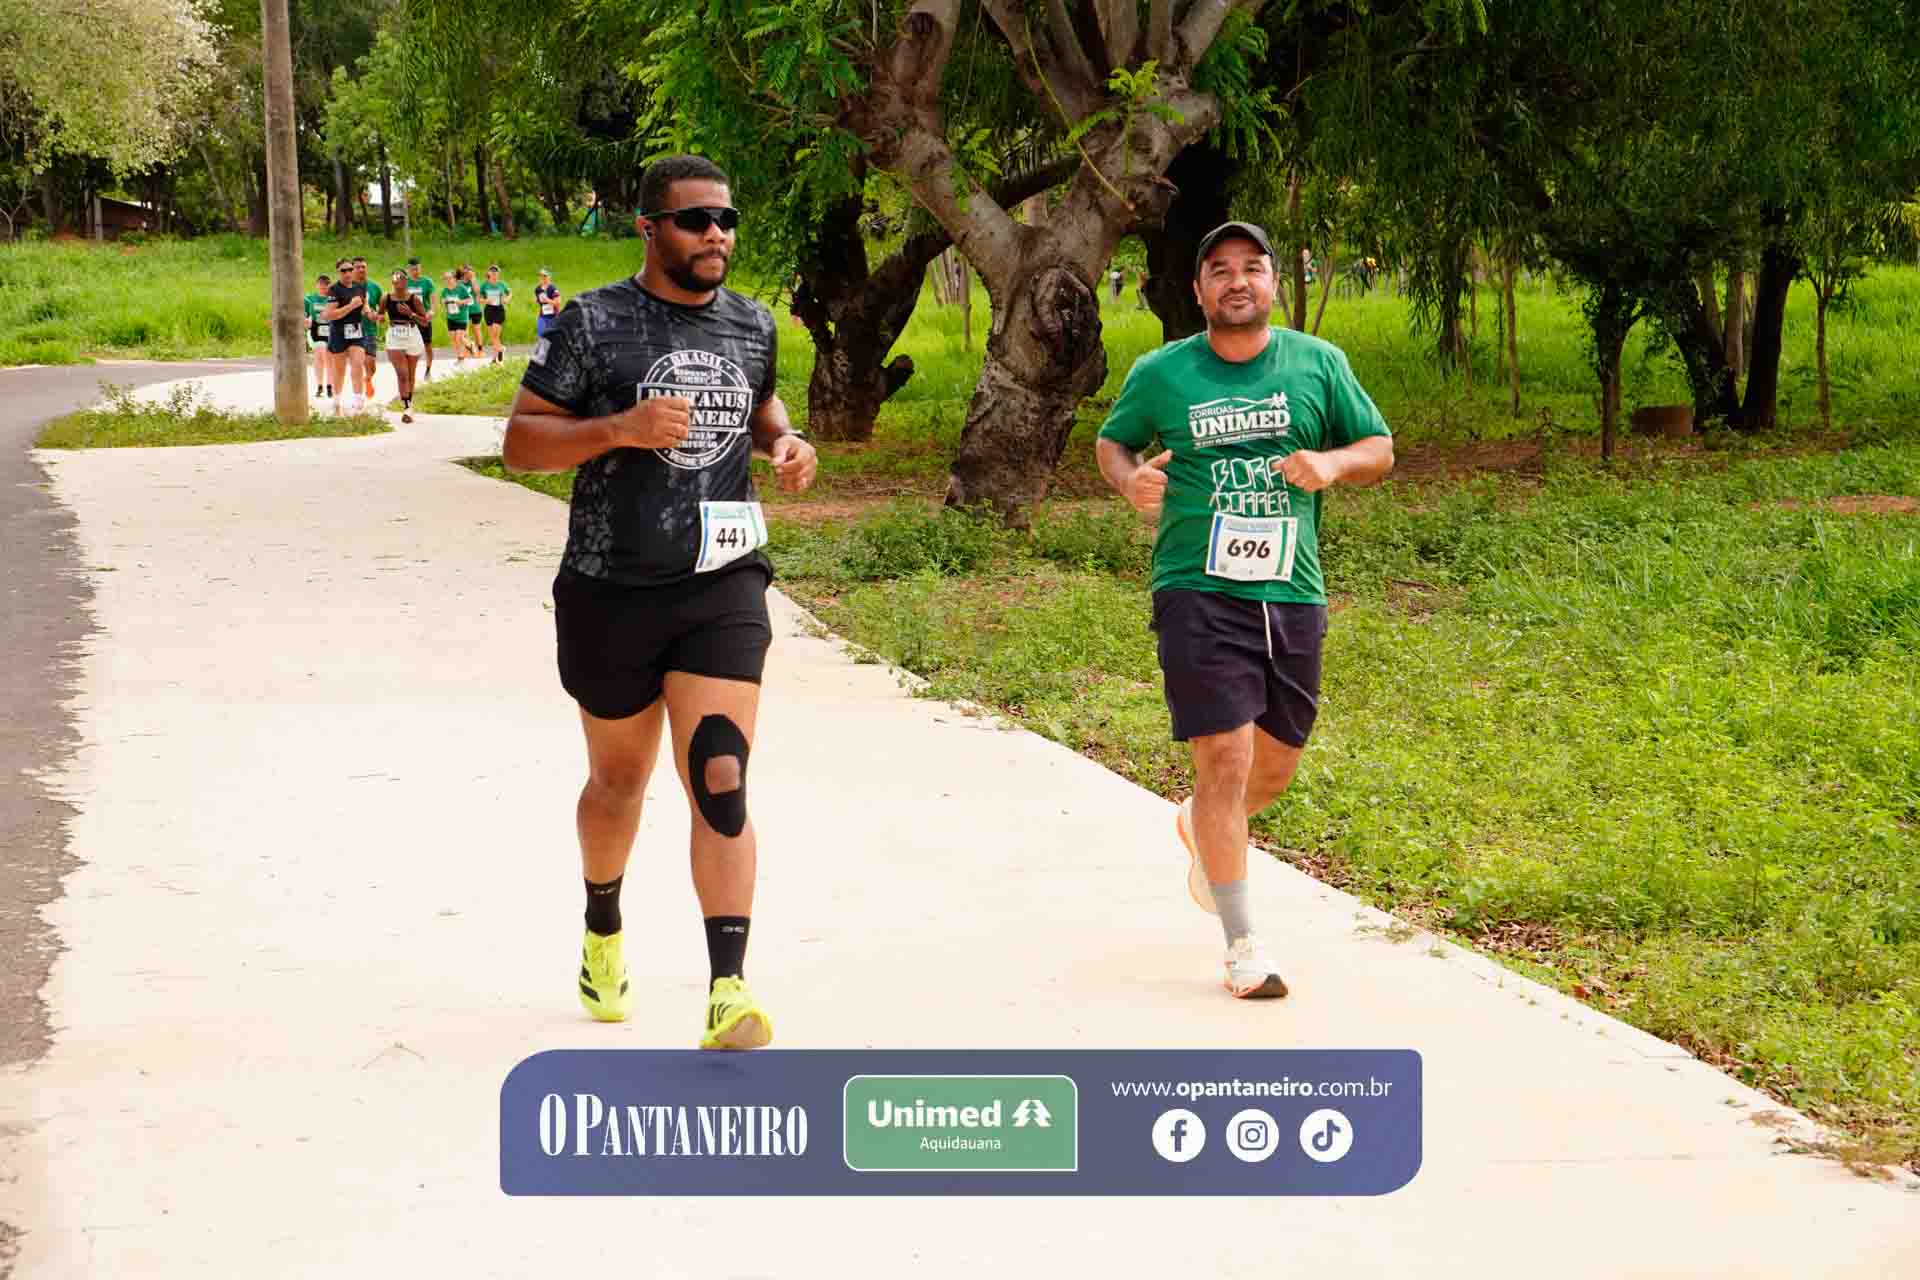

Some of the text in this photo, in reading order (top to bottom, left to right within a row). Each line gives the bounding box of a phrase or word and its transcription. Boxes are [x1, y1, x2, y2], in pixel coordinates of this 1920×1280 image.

[670, 352, 723, 369] BRASIL
[1189, 406, 1235, 419] CORRIDAS
[1190, 410, 1290, 438] UNIMED
[1209, 490, 1291, 516] CORRER
[716, 528, 747, 548] 441
[1227, 539, 1270, 558] 696
